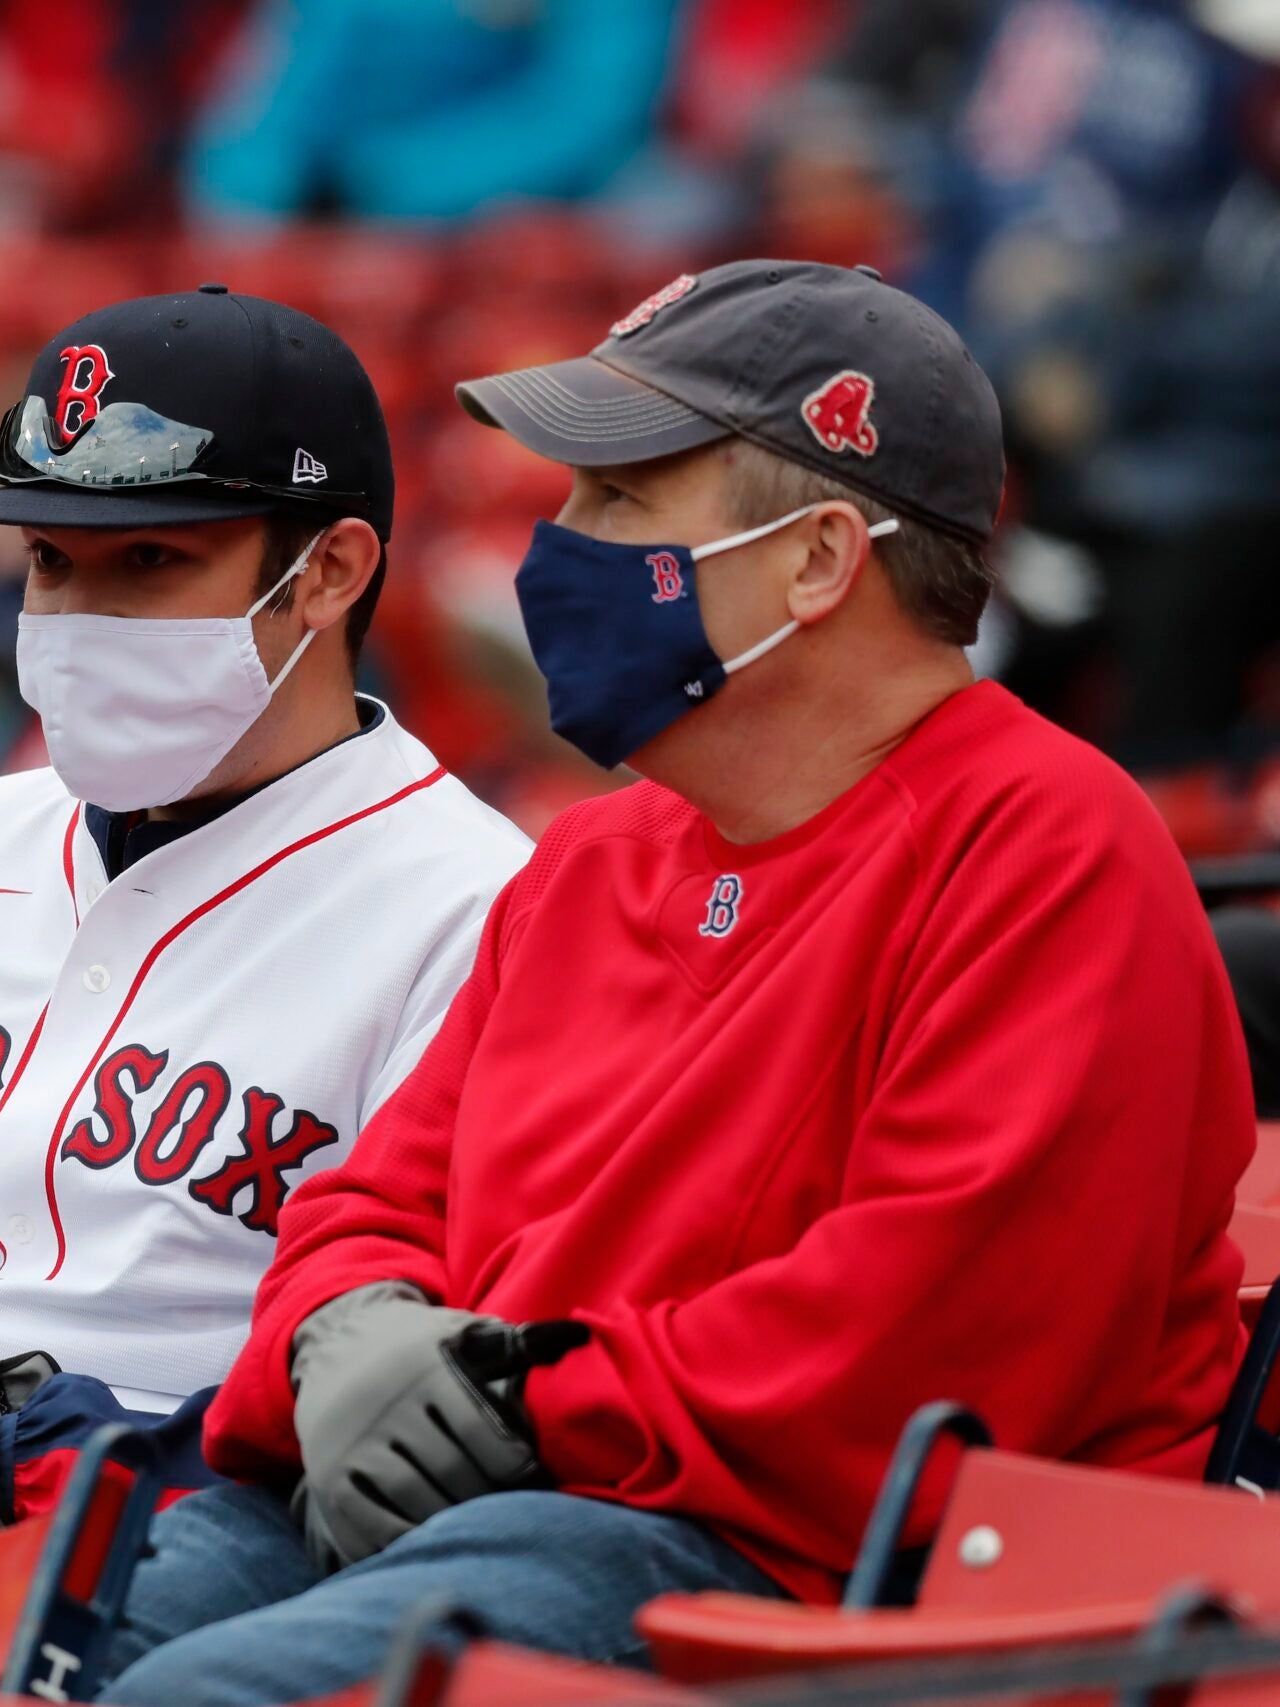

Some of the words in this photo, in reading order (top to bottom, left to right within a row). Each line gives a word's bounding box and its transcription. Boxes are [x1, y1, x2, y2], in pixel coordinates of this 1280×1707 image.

[55, 344, 116, 447] B
[645, 551, 684, 604] B
[698, 873, 744, 938] B
[61, 1043, 339, 1237] SOX
